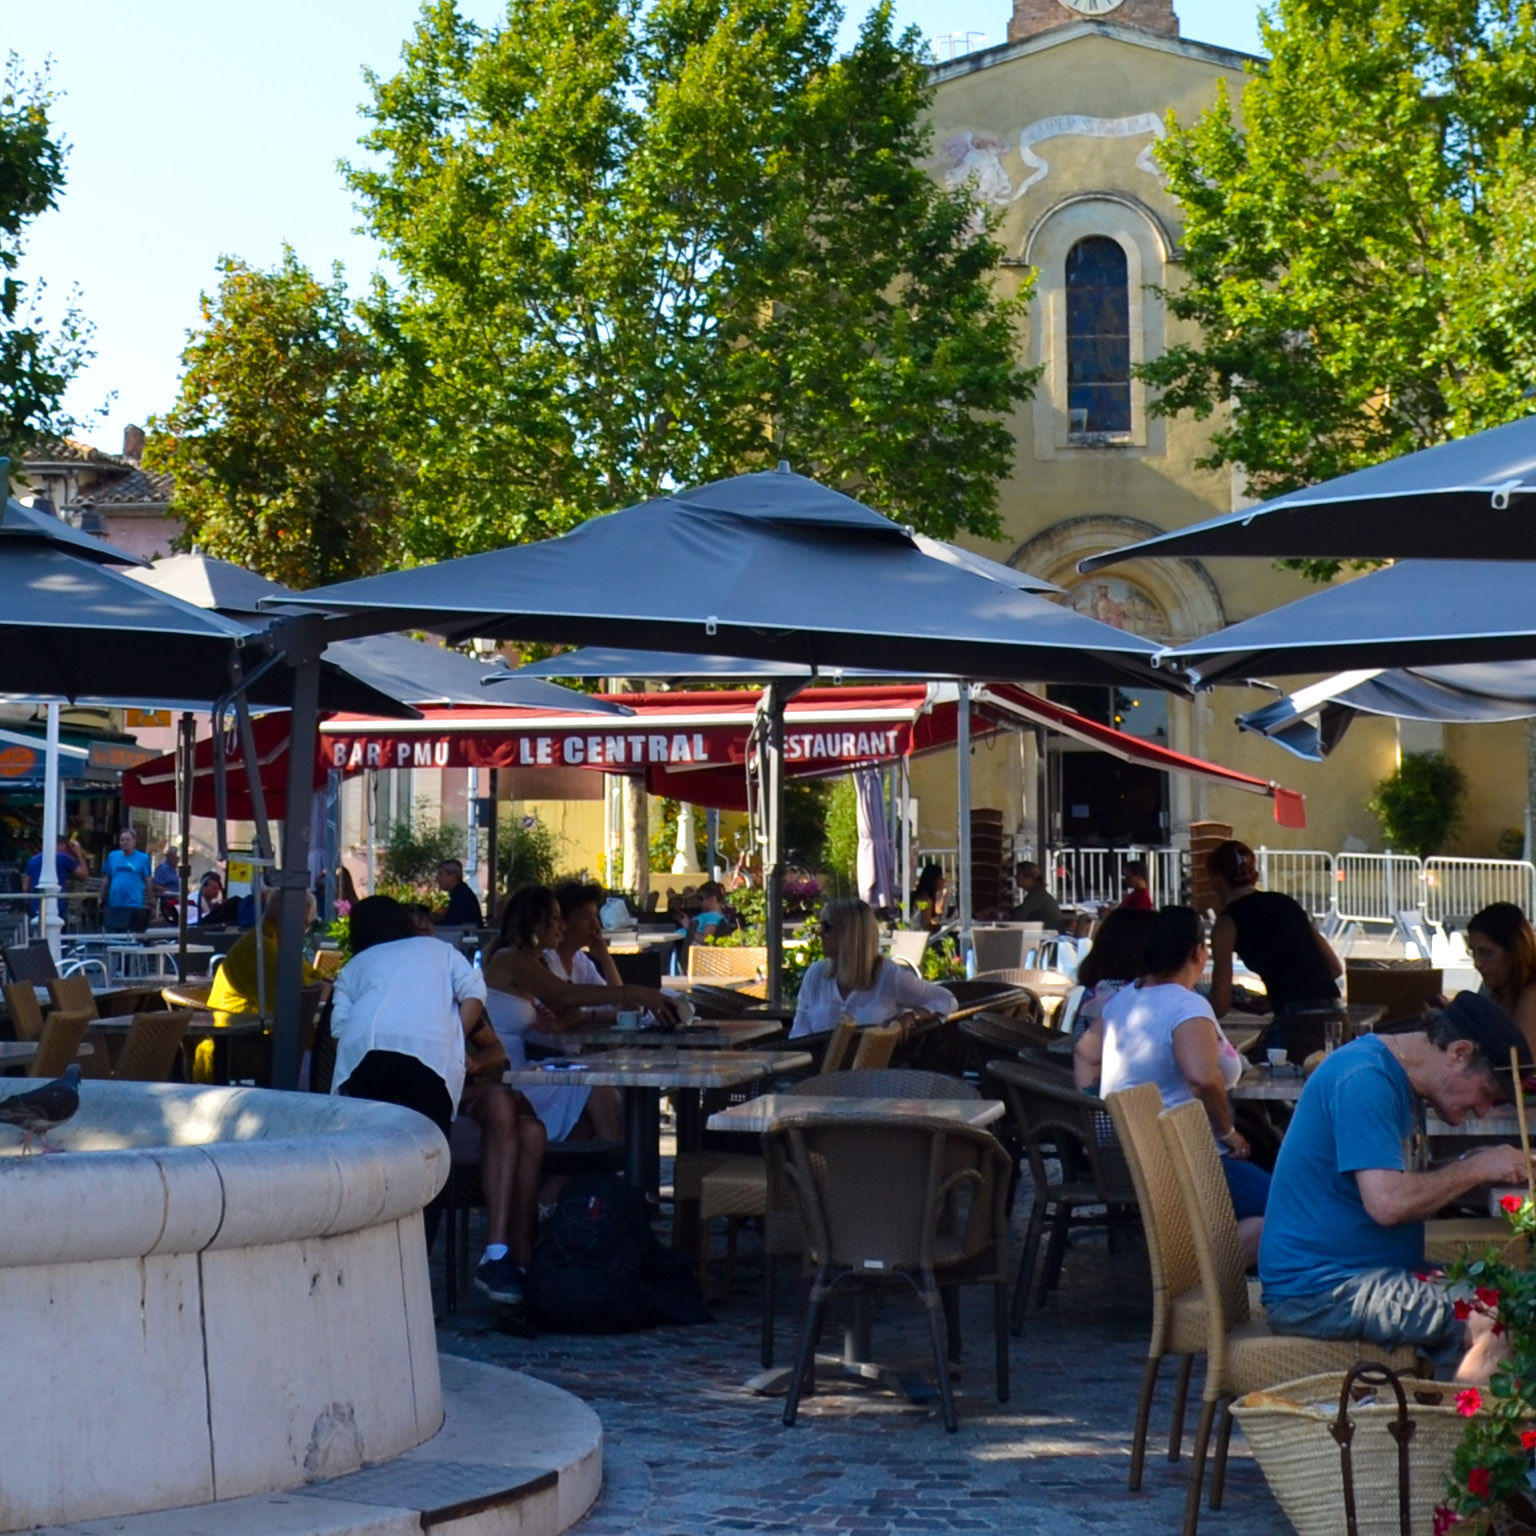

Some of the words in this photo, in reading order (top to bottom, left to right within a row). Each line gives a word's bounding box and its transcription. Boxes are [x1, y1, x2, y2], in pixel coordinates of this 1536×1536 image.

[333, 742, 381, 767] BAR
[397, 741, 450, 766] PMU
[519, 736, 552, 765] LE
[564, 733, 708, 764] CENTRAL
